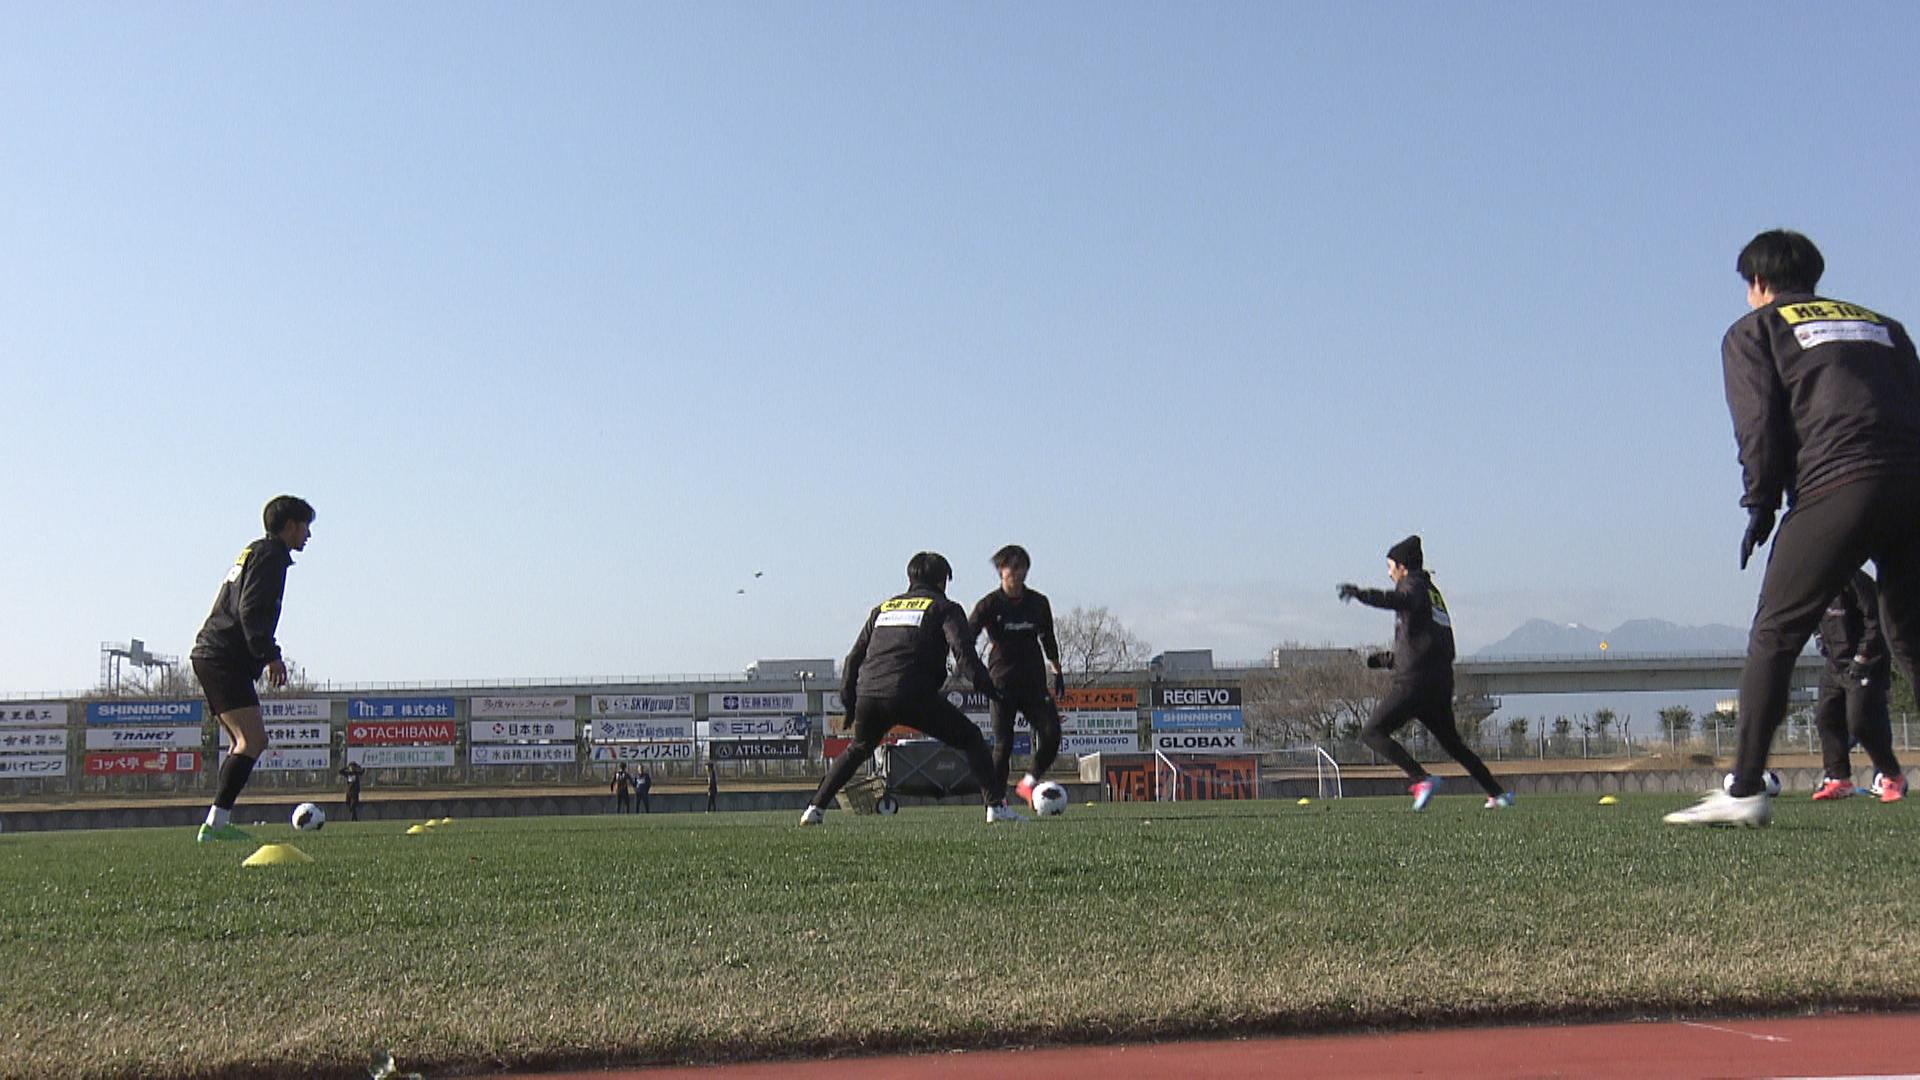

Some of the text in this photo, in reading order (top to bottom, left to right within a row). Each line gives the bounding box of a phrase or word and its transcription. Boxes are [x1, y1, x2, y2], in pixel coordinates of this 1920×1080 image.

[1163, 689, 1229, 704] REGIEVO
[98, 704, 191, 716] SHINNIHON
[1163, 713, 1232, 722] SHINNIHON
[368, 726, 449, 738] TACHIBANA
[509, 723, 554, 736] 日本生命
[1160, 736, 1235, 748] GLOBAX
[736, 744, 760, 755] ATIS
